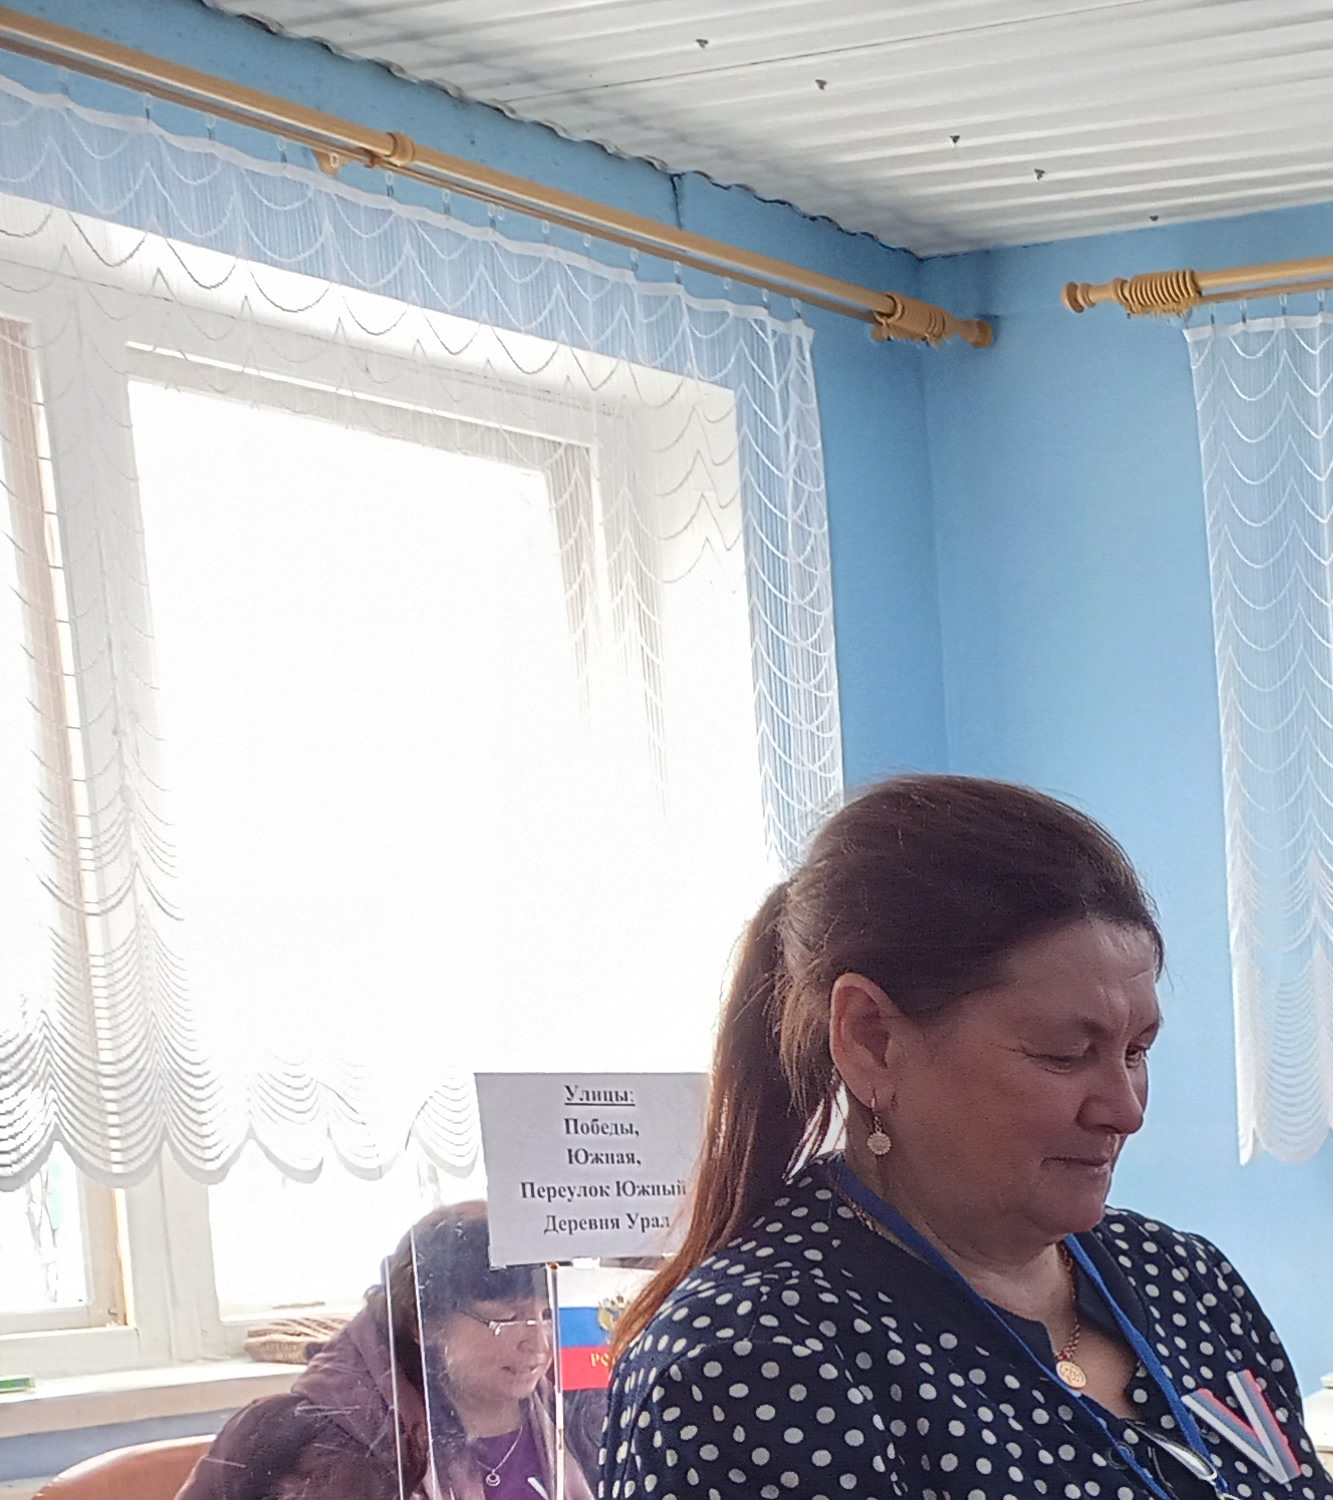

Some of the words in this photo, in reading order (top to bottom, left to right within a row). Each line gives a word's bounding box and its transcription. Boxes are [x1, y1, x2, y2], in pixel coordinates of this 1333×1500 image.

[564, 1118, 639, 1137] Победы,
[567, 1148, 641, 1166] Южная,
[521, 1181, 611, 1202] Переулок
[543, 1215, 620, 1236] Деревня
[626, 1213, 670, 1234] Урал
